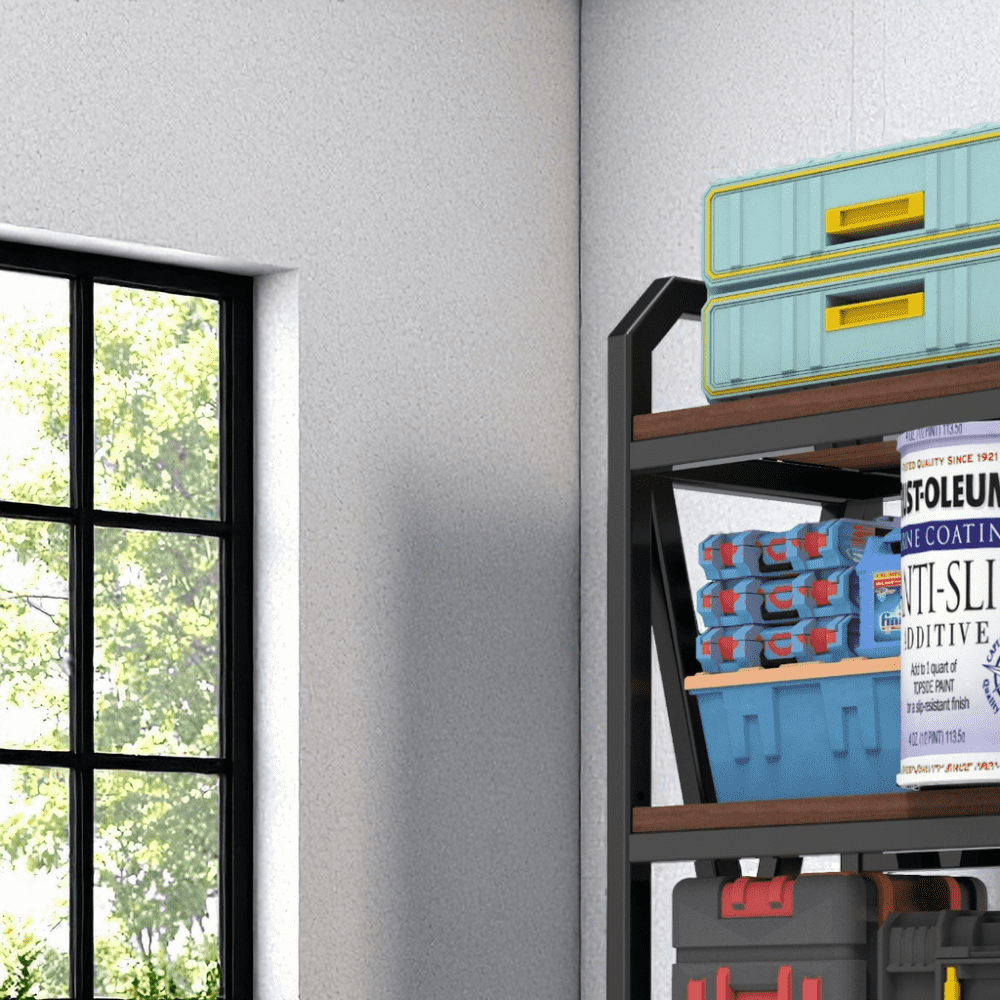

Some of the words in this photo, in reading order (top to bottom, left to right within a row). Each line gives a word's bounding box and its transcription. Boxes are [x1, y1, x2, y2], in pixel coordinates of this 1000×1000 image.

[917, 457, 944, 469] QUALITY
[948, 454, 974, 466] SINCE
[977, 452, 999, 462] 1921
[930, 661, 948, 676] quart
[950, 658, 958, 674] of
[935, 679, 954, 692] PAINT
[951, 696, 970, 710] finish
